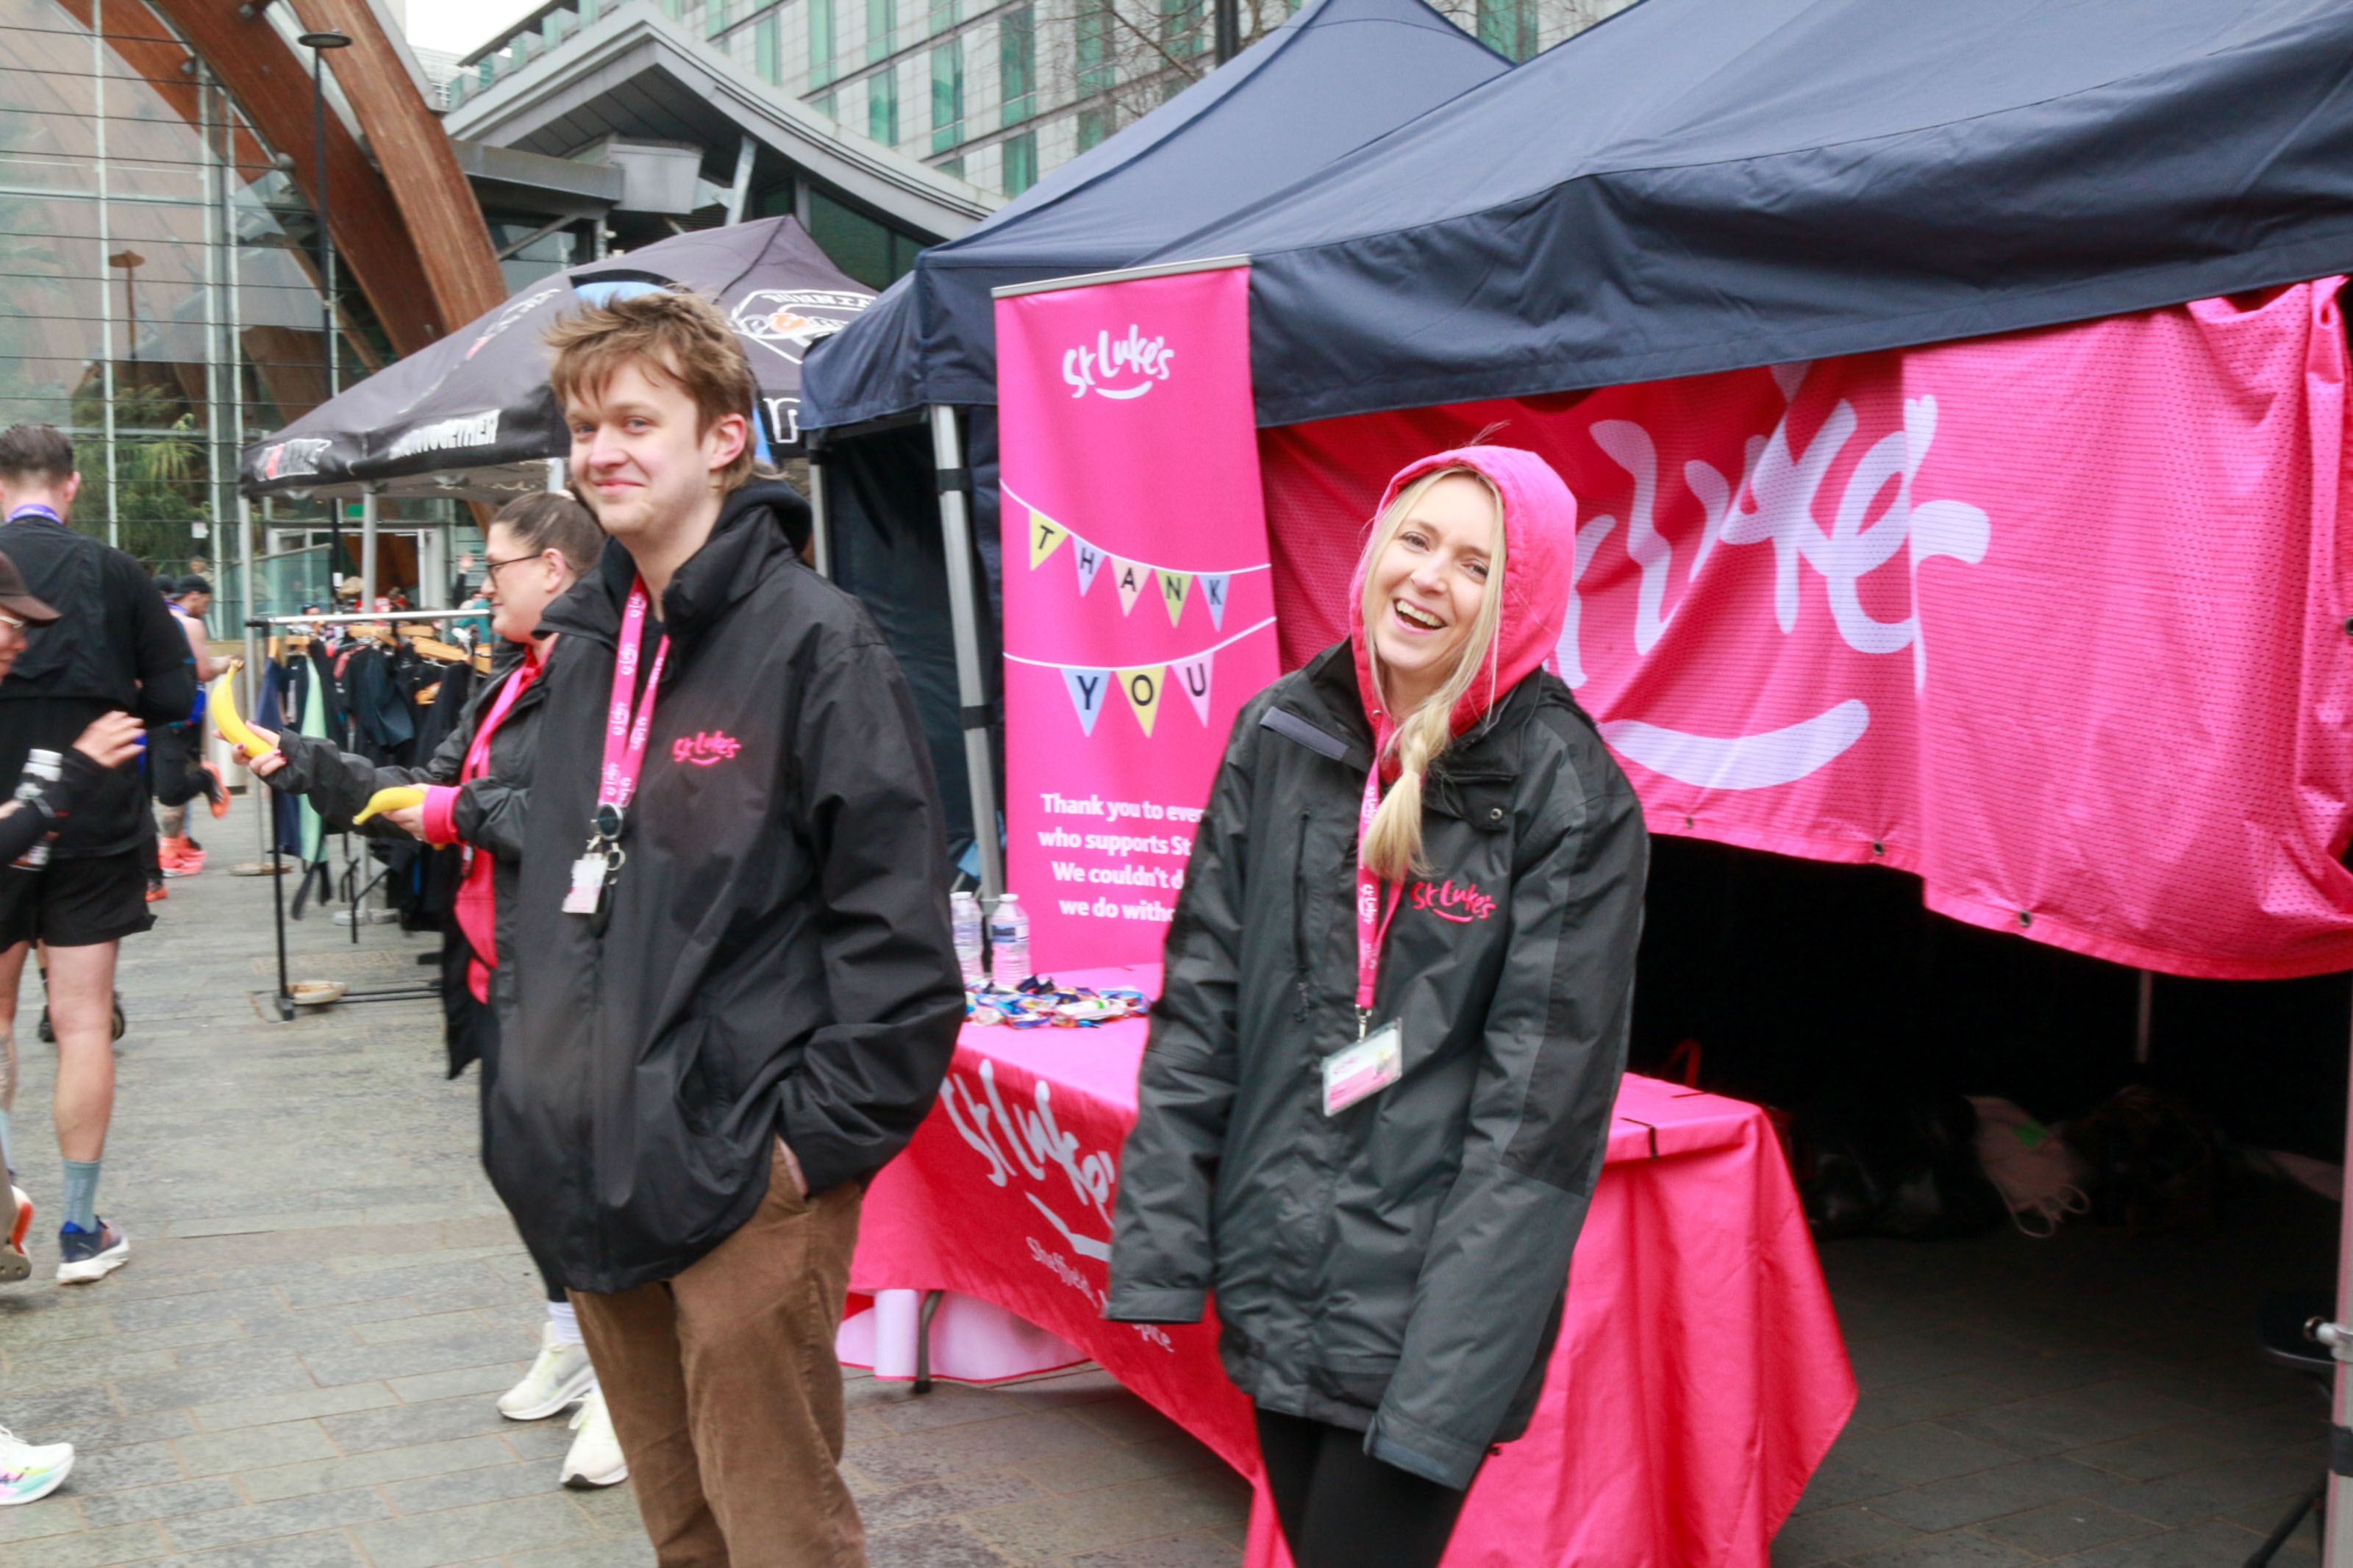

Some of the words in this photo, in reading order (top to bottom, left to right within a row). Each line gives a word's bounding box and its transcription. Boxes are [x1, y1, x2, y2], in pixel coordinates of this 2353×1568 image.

[1063, 346, 1096, 398] St
[1098, 323, 1175, 379] Luke's
[1038, 524, 1224, 606] THANK
[1076, 662, 1207, 711] YOU
[1040, 792, 1104, 815] Thank
[1105, 801, 1141, 822] you
[1141, 801, 1164, 820] to
[1165, 805, 1204, 823] ever
[1037, 826, 1082, 847] who
[1085, 834, 1168, 856] supports
[1171, 836, 1191, 856] St
[1051, 862, 1085, 882] We
[1088, 864, 1169, 888] couldn't
[1171, 869, 1185, 889] d
[1059, 900, 1090, 916] we
[1092, 897, 1118, 917] do
[1410, 881, 1439, 910] St
